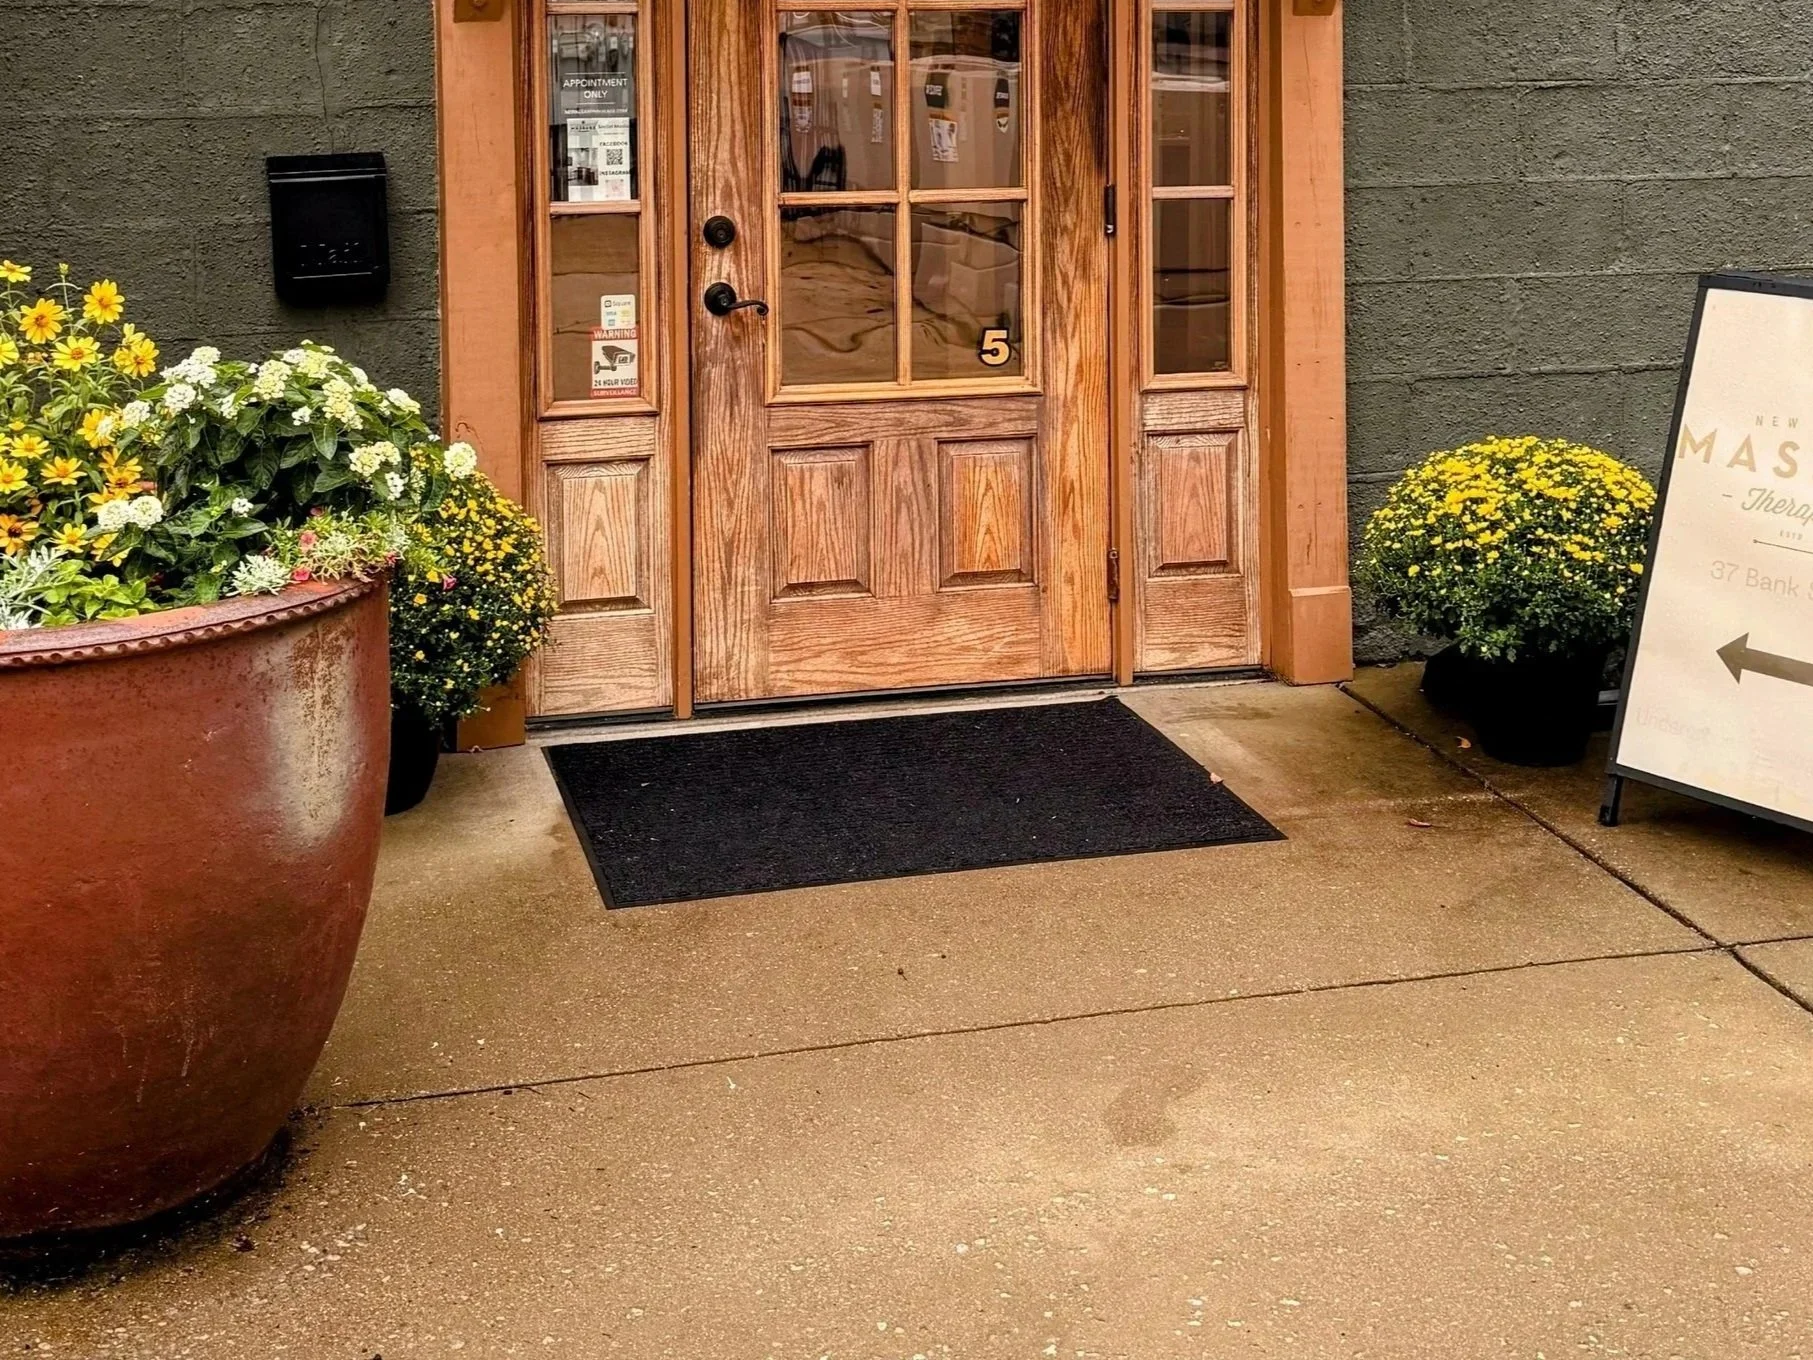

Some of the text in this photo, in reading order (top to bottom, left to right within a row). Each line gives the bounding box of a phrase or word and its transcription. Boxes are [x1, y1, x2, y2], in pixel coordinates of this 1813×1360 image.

[563, 78, 628, 88] APPOINTMENT
[583, 90, 608, 99] ONLY
[593, 329, 637, 339] WARNING
[978, 327, 1012, 367] 5
[1755, 415, 1799, 429] NEW
[1678, 423, 1813, 479] MAS
[1711, 560, 1740, 582] 37
[1746, 567, 1800, 598] Bank
